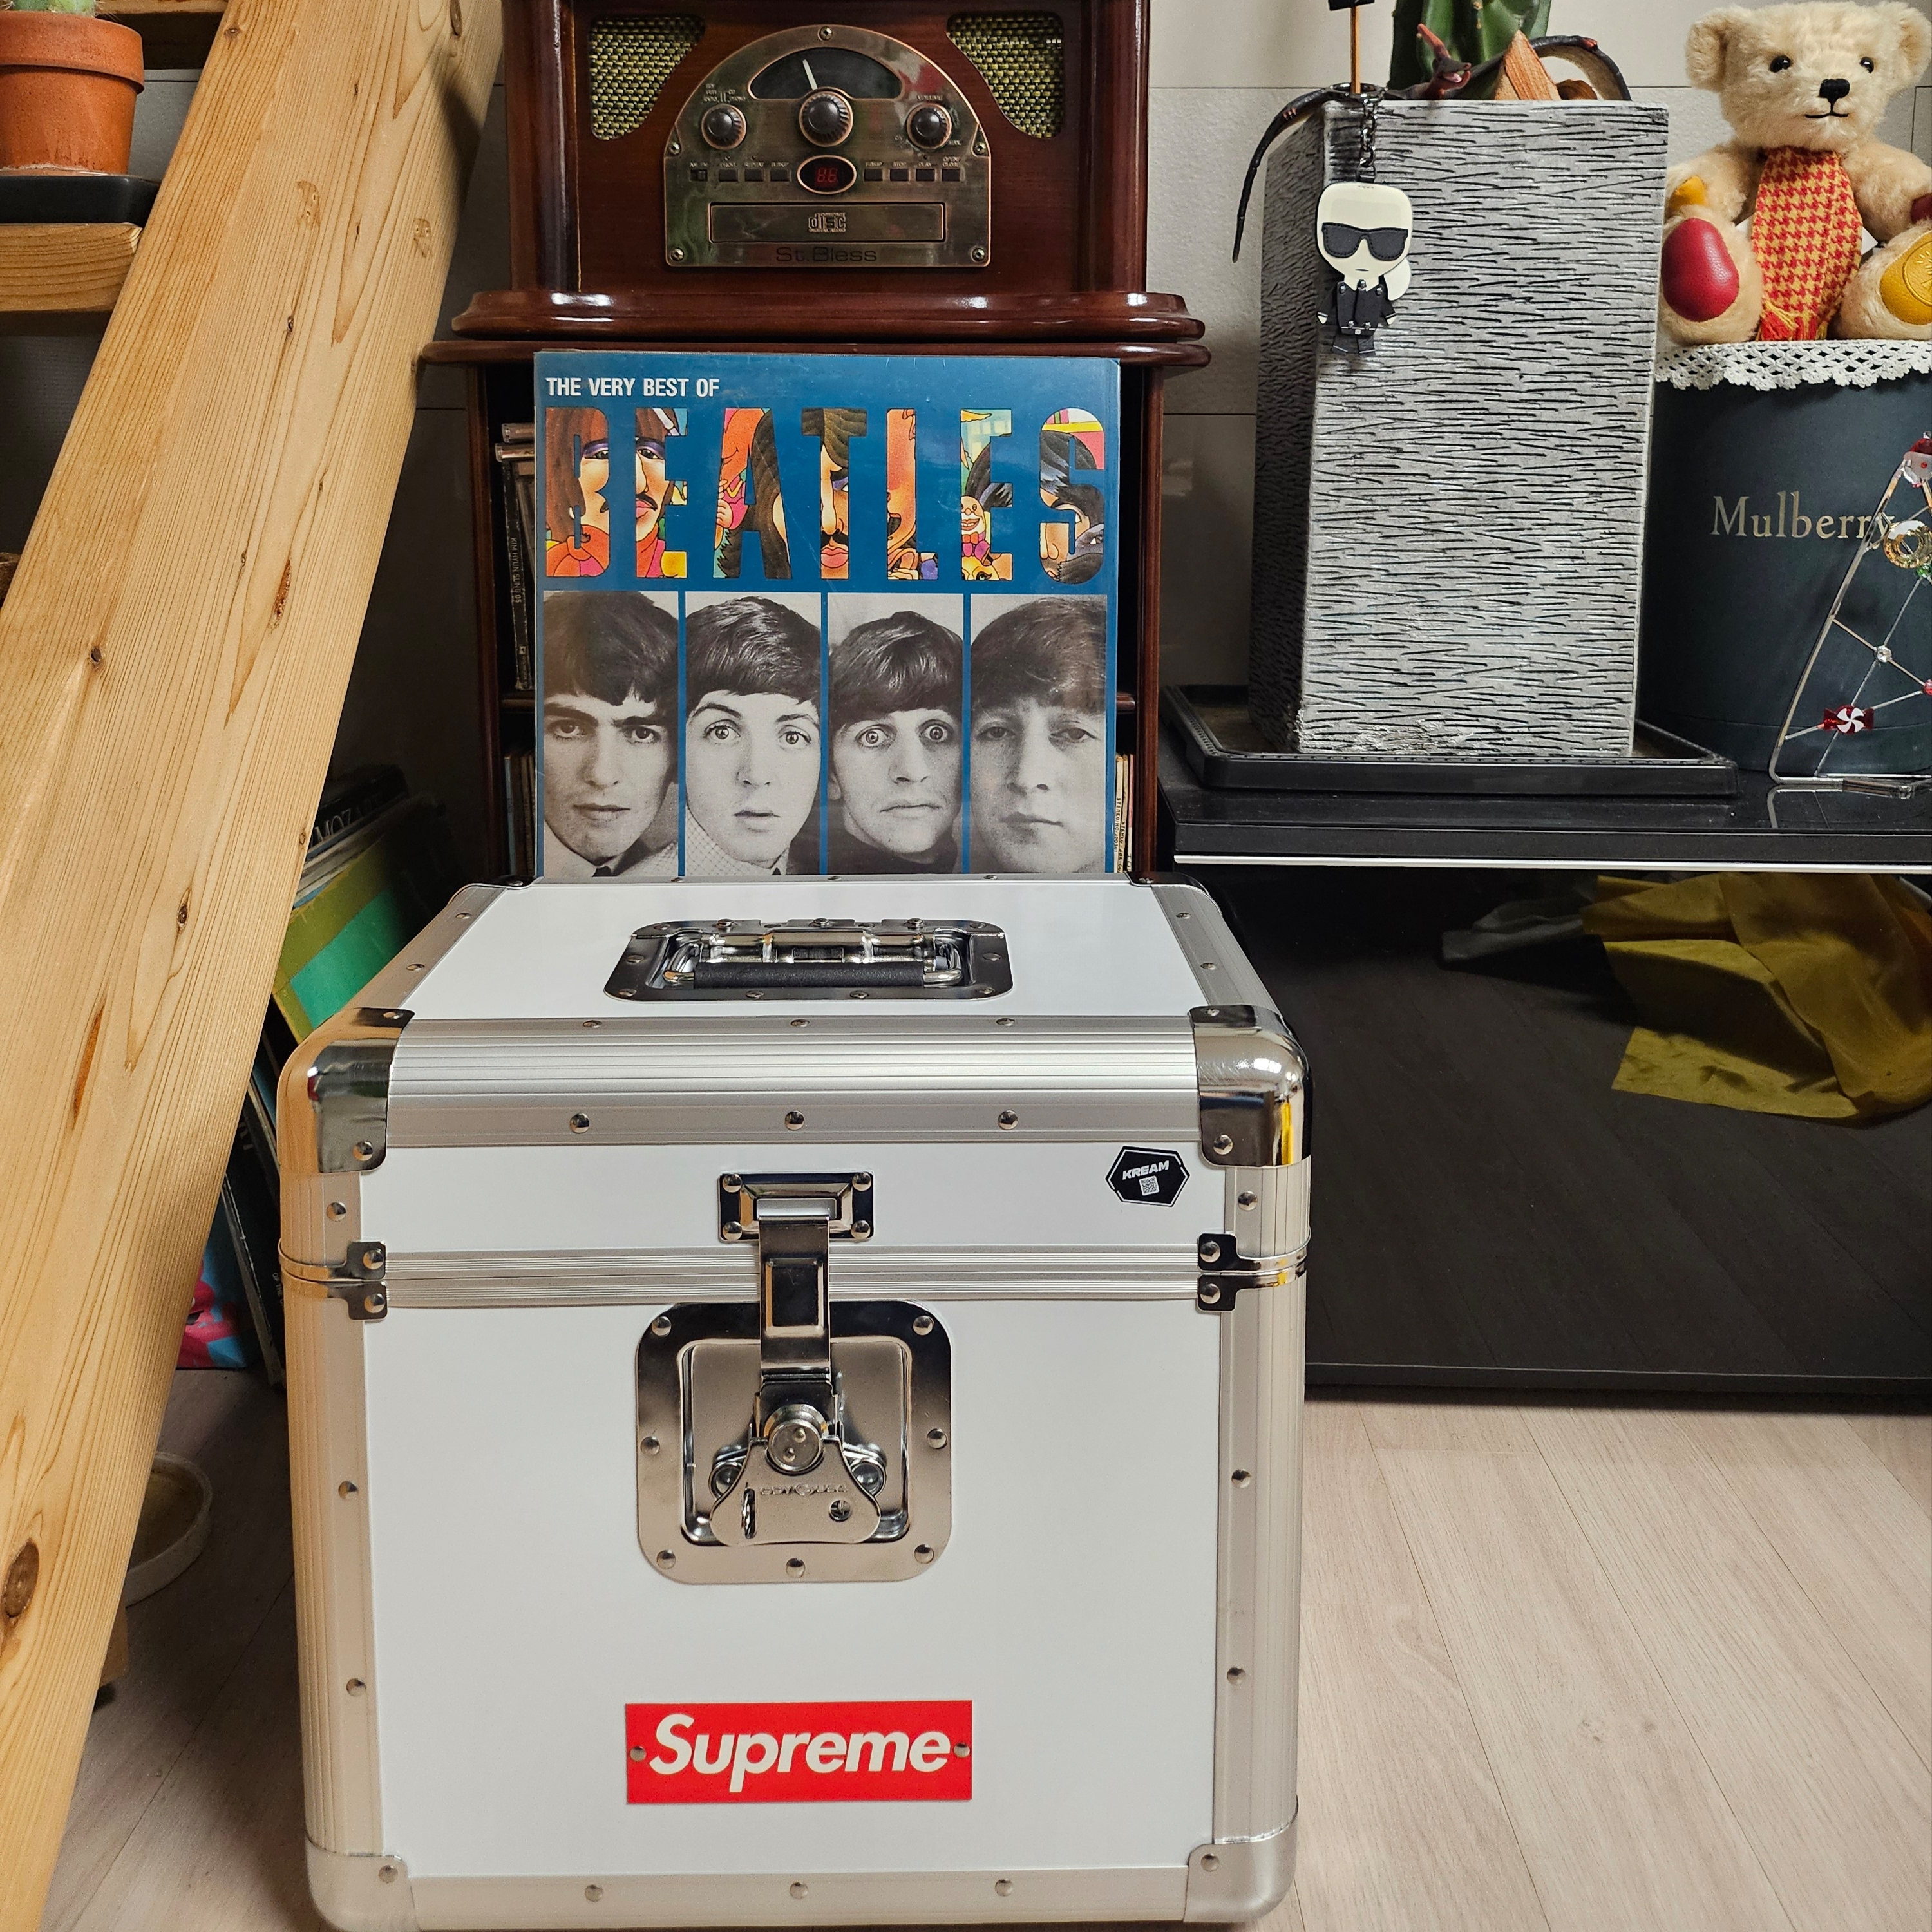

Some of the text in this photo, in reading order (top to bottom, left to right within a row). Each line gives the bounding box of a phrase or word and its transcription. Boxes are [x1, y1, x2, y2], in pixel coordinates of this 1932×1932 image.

[546, 378, 721, 398] THE VERY BEST OF
[545, 407, 1105, 585] BEATLES
[1122, 1160, 1170, 1180] KREAM
[649, 1713, 951, 1794] Supreme
